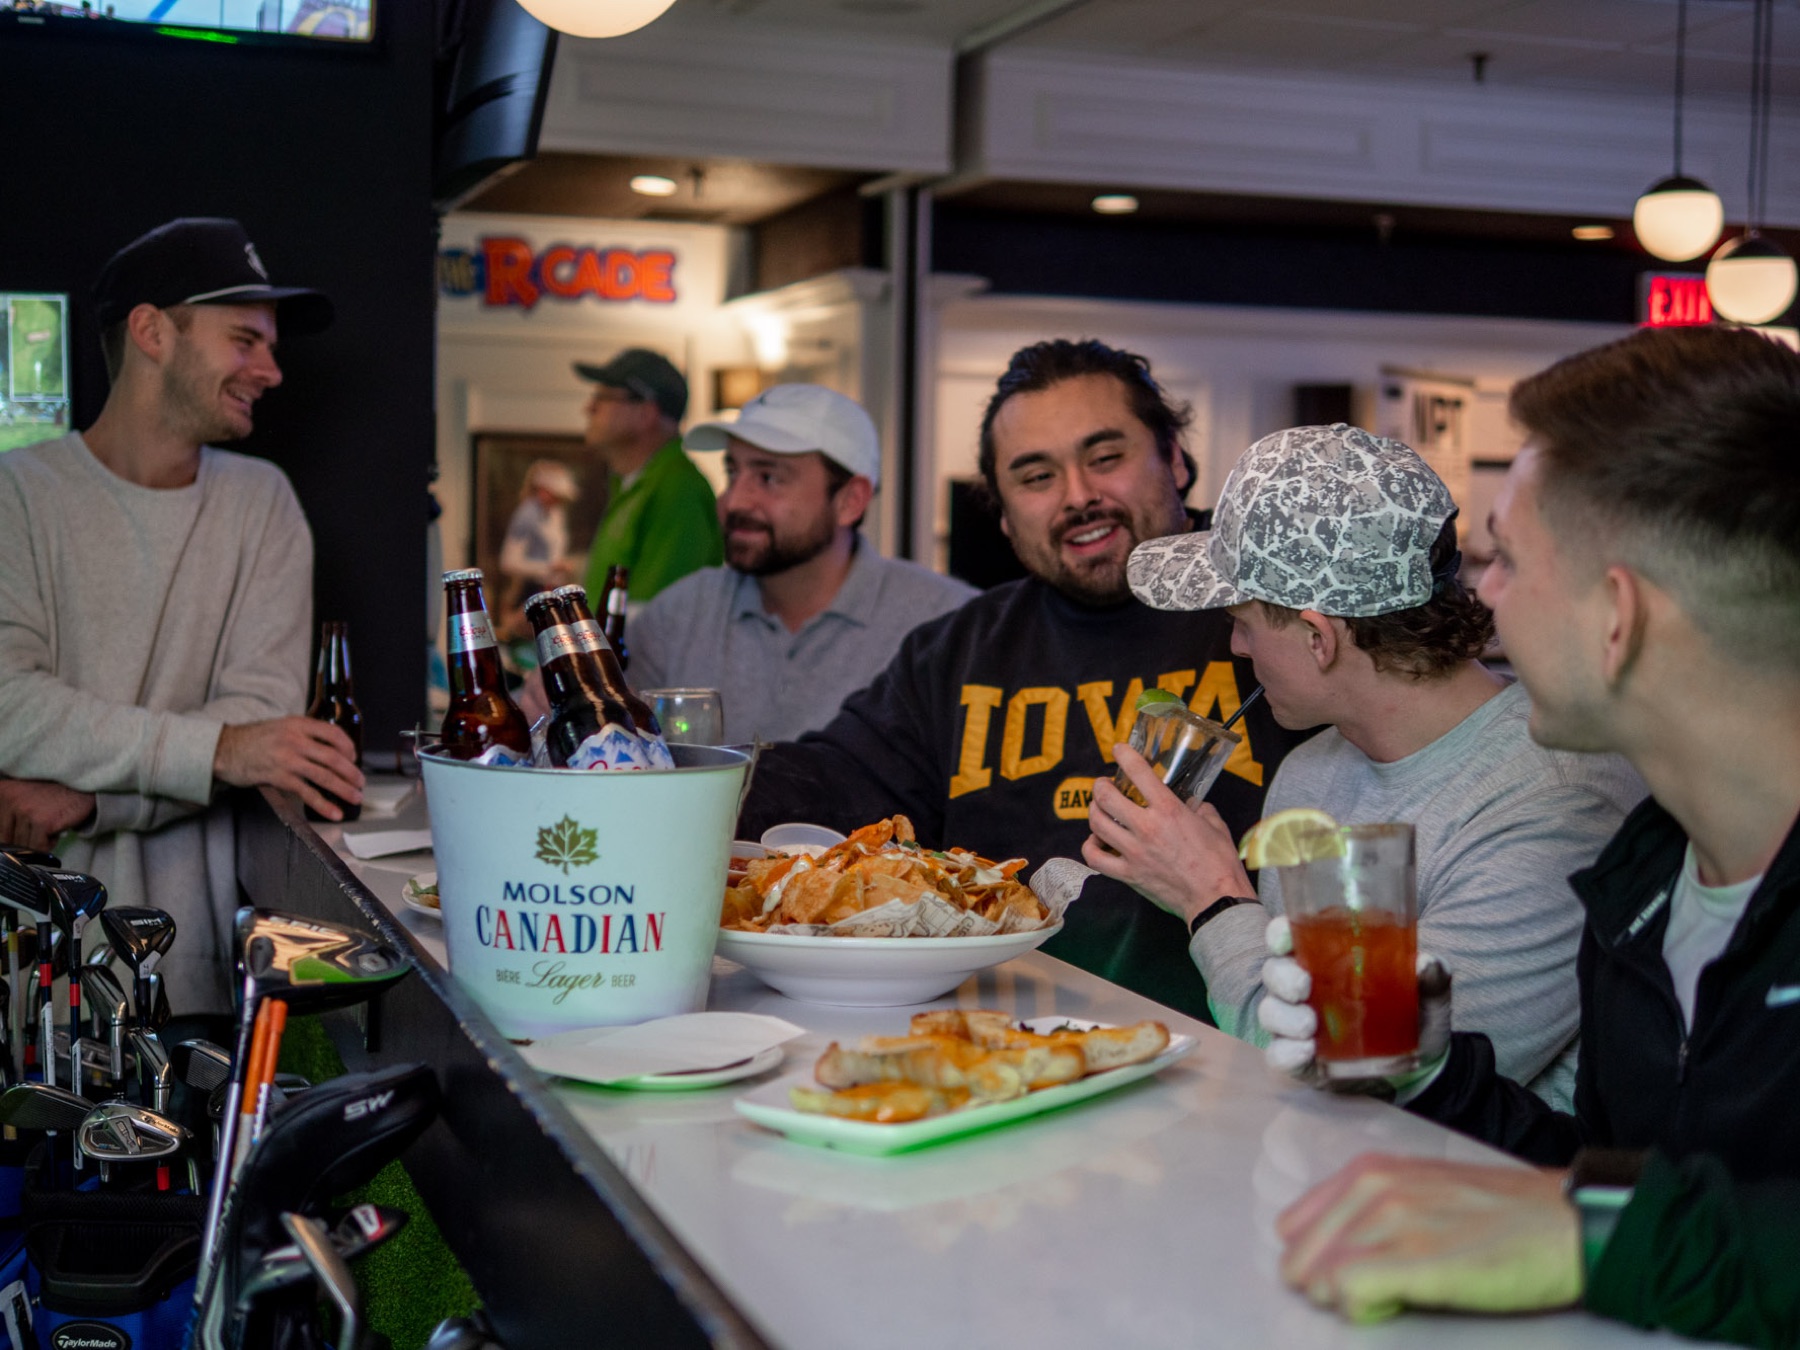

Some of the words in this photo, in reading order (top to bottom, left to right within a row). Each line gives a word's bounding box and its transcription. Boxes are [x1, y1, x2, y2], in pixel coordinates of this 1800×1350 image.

[949, 660, 1264, 799] IOWA
[502, 881, 634, 906] MOLSON
[475, 904, 667, 955] CANADIAN
[496, 968, 521, 985] BIÈRE
[525, 959, 606, 1006] Lager
[611, 974, 636, 988] BEER
[343, 1090, 395, 1122] SW
[58, 1335, 117, 1348] TaylorMade
